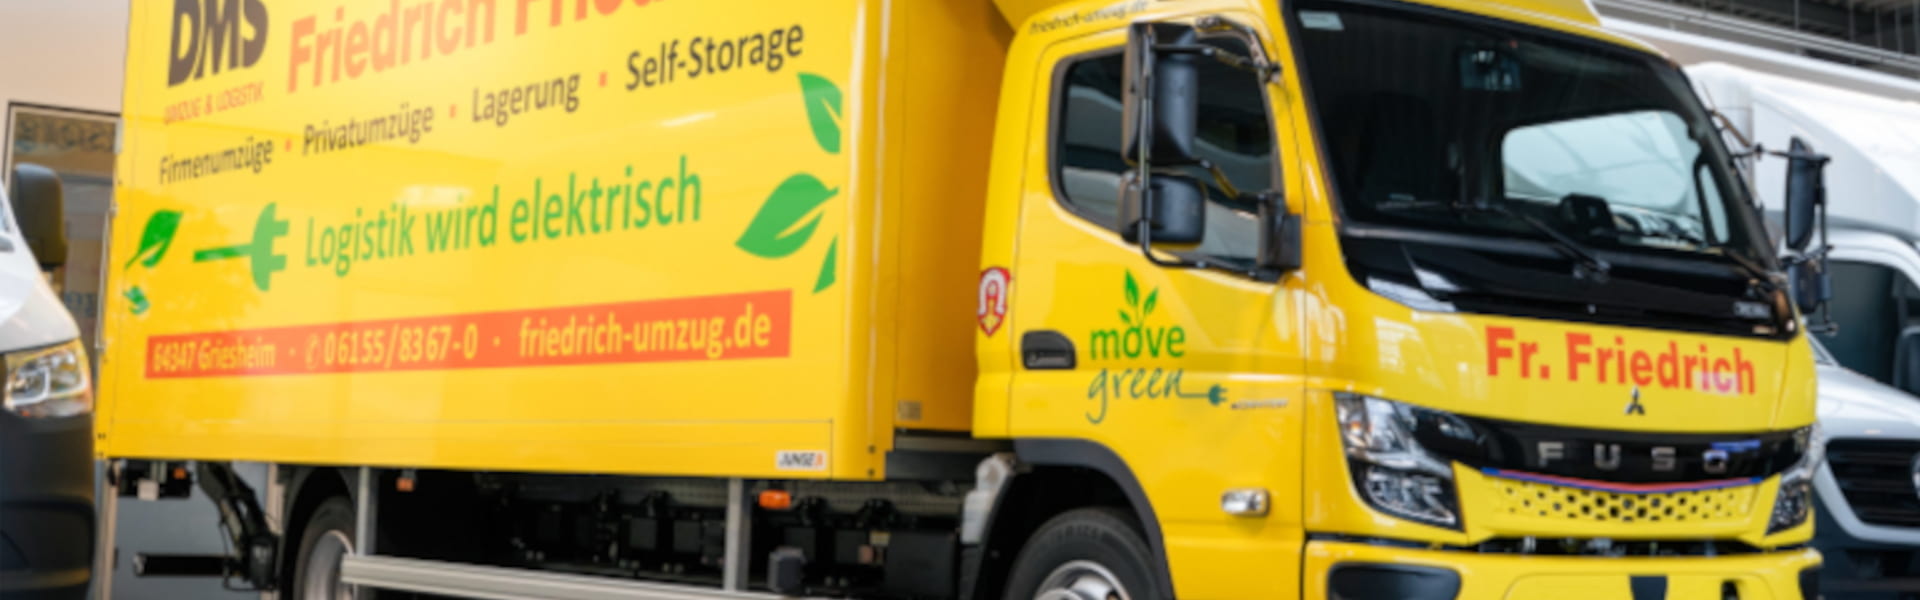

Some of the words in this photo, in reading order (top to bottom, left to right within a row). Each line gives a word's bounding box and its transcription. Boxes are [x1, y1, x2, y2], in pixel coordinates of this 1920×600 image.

[168, 0, 269, 87] DMS
[287, 0, 497, 94] Friedrich
[160, 137, 274, 184] Firmenumzüge
[303, 104, 434, 155] Privatumzüge
[472, 73, 581, 127] Lagerung
[626, 24, 804, 91] Self-Storage
[305, 203, 416, 278] Logistik
[425, 184, 498, 251] wird
[510, 154, 702, 243] elektrisch
[198, 336, 276, 371] Griesheim
[323, 324, 479, 369] 06155/8367-0
[519, 301, 773, 360] friedrich-umzug.de
[1090, 326, 1186, 361] move
[1485, 326, 1551, 379] Fr.
[1565, 331, 1756, 394] Friedrich
[1085, 367, 1185, 424] green
[1537, 441, 1729, 474] FUSO
